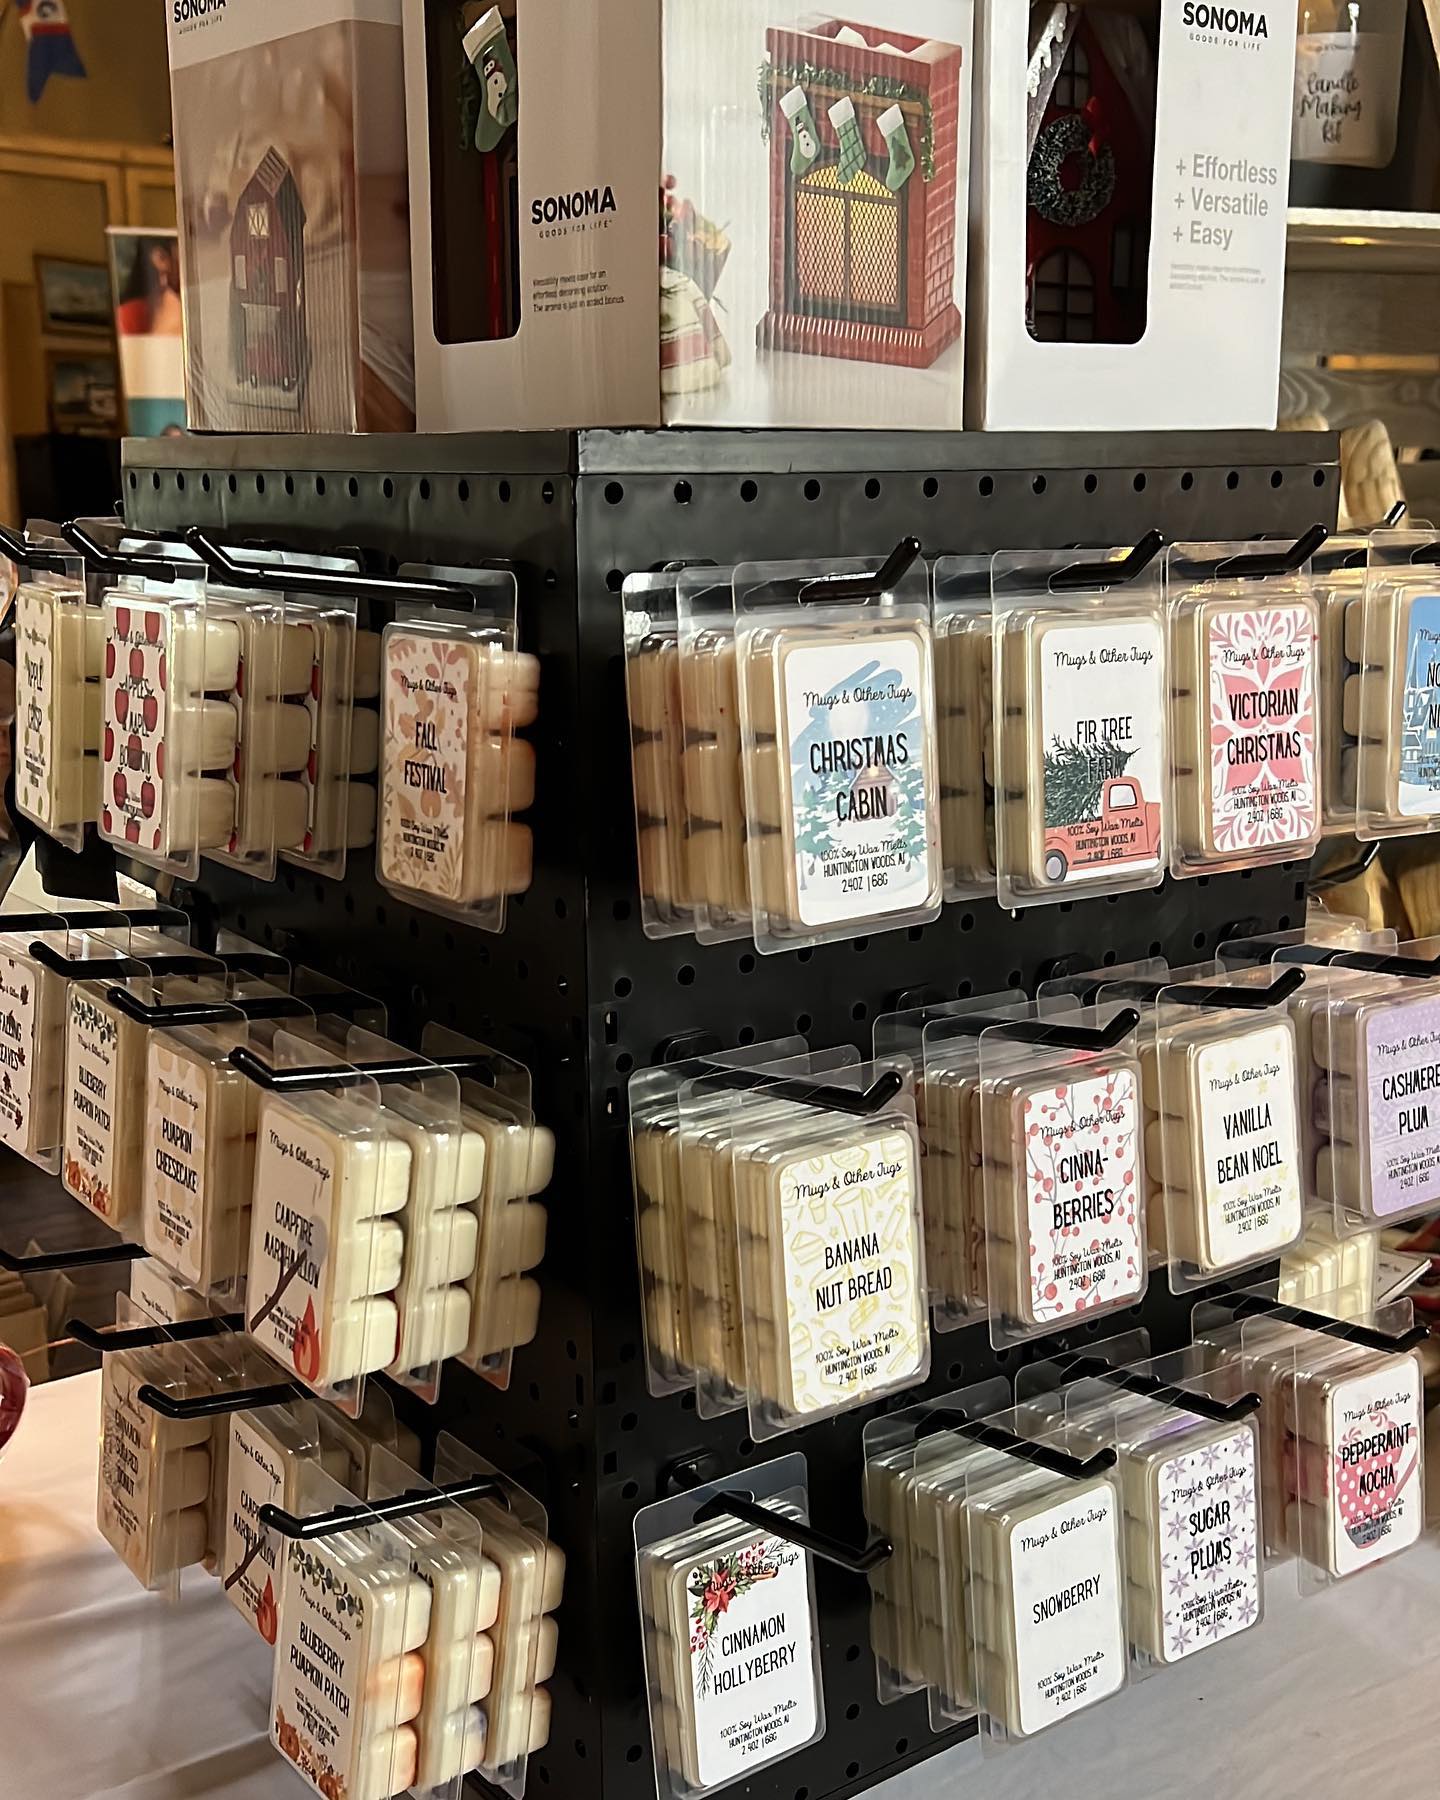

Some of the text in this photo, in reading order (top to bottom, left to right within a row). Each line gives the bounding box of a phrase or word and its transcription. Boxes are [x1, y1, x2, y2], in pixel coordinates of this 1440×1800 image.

[1183, 2, 1268, 38] SONOMA
[1189, 33, 1261, 51] GOODS FOR LIFE
[1300, 96, 1362, 120] Making
[1192, 153, 1278, 185] Effortless
[531, 186, 616, 225] SONOMA
[1191, 187, 1268, 216] Versatile
[539, 227, 567, 239] GOODS
[1190, 220, 1233, 250] Easy
[1054, 646, 1153, 670] Mugs & Other Jugs
[1223, 649, 1250, 667] Mugs
[1260, 646, 1285, 661] Other
[1286, 644, 1305, 662] Jugs
[803, 684, 912, 711] Mugs & Other Jugs
[1229, 688, 1299, 721] VICTORIAN
[415, 722, 437, 751] FALL
[1076, 716, 1133, 744] FIR TREE
[810, 732, 909, 774] CHRISTMAS
[1227, 731, 1301, 766] CHRISTMAS
[404, 760, 447, 794] FESTIVAL
[1087, 756, 1123, 784] FARM
[836, 785, 888, 821] CABIN
[823, 858, 869, 878] HUNTINGTON
[841, 846, 857, 860] Soy
[1377, 1043, 1400, 1056] Mugs
[1408, 1034, 1429, 1048] Other
[1209, 1078, 1234, 1092] Mugs
[1242, 1069, 1263, 1083] Other
[1264, 1063, 1280, 1078] Jugs
[1382, 1063, 1440, 1101] CASHMERE
[162, 1117, 193, 1155] PUMPKIN
[1039, 1125, 1067, 1141] Mugs
[1079, 1114, 1105, 1131] Other
[1106, 1109, 1125, 1124] Jugs
[1223, 1103, 1272, 1140] VANILLA
[1399, 1105, 1429, 1136] PLUM
[156, 1149, 198, 1194] CHEESECAKE
[1060, 1148, 1109, 1185] CINNA-
[1218, 1140, 1283, 1185] BEAN NOEL
[793, 1162, 902, 1201] Mugs & Other Jugs
[275, 1201, 314, 1246] CAMPFIRE
[1053, 1188, 1114, 1230] BERRIES
[825, 1232, 880, 1270] BANANA
[815, 1266, 892, 1312] NUT BREAD
[836, 1345, 851, 1357] Soy
[873, 1328, 899, 1343] Melts
[825, 1354, 862, 1376] HUNTINGTON
[1343, 1410, 1366, 1424] Mugs
[1373, 1399, 1394, 1412] Other
[1395, 1392, 1412, 1405] Jugs
[1342, 1422, 1412, 1469] PEPPERMINT
[1171, 1487, 1197, 1503] Mugs
[1206, 1473, 1228, 1490] Other
[1228, 1466, 1246, 1481] Jugs
[1359, 1464, 1396, 1498] MOCHA
[1020, 1508, 1108, 1552] Mugs & Other Jugs
[1189, 1500, 1231, 1537] SUGAR
[777, 1552, 799, 1567] Jugs
[1190, 1536, 1232, 1574] PLUMS
[1033, 1574, 1101, 1625] SNOWBERRY
[300, 1621, 345, 1679] BLUEBERRY
[722, 1612, 786, 1657] CINNAMON
[290, 1644, 323, 1693] PUMPKIN
[324, 1678, 350, 1719] PATCH
[714, 1641, 797, 1696] HOLLYBERRY
[739, 1720, 752, 1730] Soy
[773, 1699, 797, 1715] Melts
